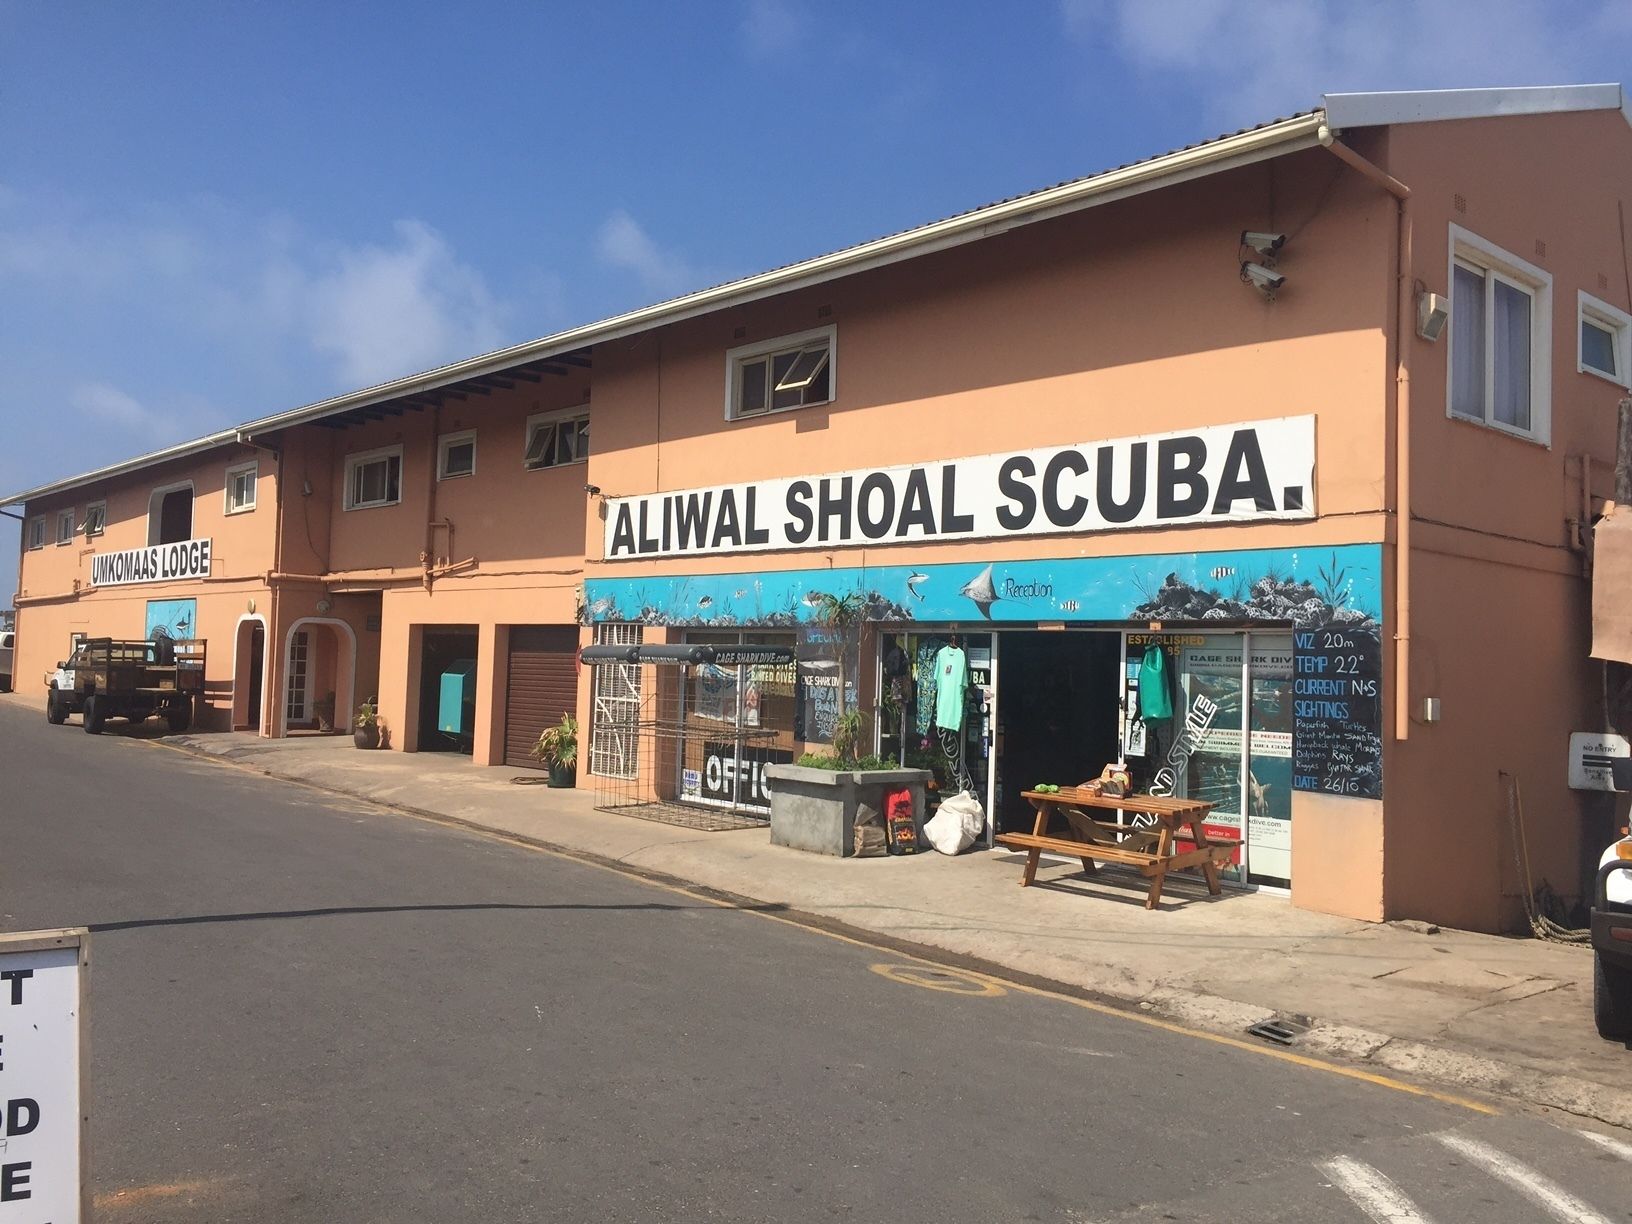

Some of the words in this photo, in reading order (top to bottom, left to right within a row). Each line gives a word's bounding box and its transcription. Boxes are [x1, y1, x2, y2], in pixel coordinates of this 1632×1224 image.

[610, 486, 770, 556] ALIWAL
[784, 465, 974, 544] SHOAL
[92, 548, 158, 584] UMKOMAAS
[162, 541, 209, 578] LODGE
[1004, 578, 1053, 600] Reception
[1295, 633, 1315, 649] VIZ
[1324, 632, 1354, 648] 20m
[716, 652, 736, 664] CAGE
[1226, 655, 1267, 663] SHRK
[1271, 656, 1292, 664] DIV
[1295, 655, 1328, 673] TEMP
[1295, 679, 1347, 696] CURRENT
[1294, 700, 1349, 719] SIGHTINGS
[706, 754, 772, 801] OFFIC
[1294, 775, 1318, 789] DATE
[1323, 777, 1359, 793] 26/10
